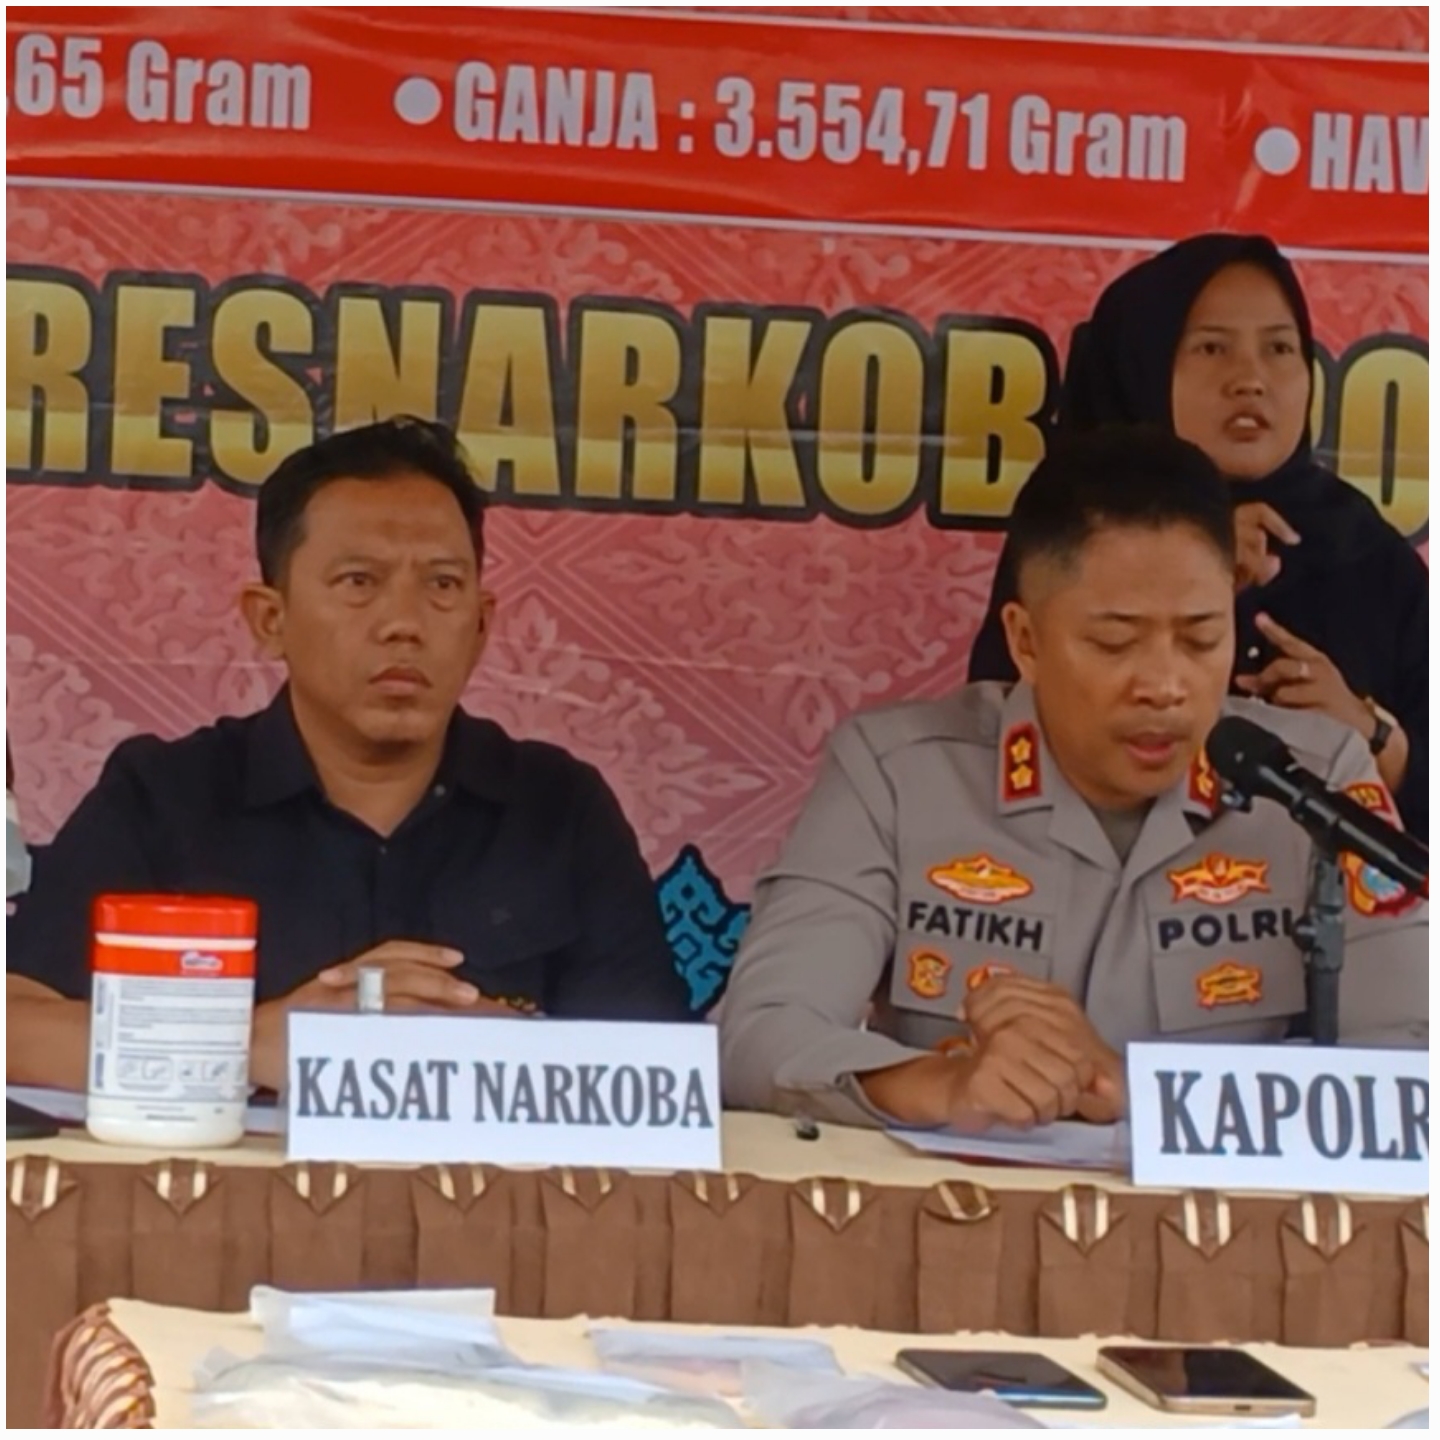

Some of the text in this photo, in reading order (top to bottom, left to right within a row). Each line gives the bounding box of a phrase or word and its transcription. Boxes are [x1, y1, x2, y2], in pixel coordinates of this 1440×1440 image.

[13, 32, 1429, 195] 65 Gram GANJA : 3.554,71 Gram HAV
[907, 901, 1045, 952] FATIKH
[1159, 907, 1296, 951] POLRI
[296, 1057, 714, 1128] KASAT NARKOBA
[1154, 1070, 1429, 1161] KAPOLR
